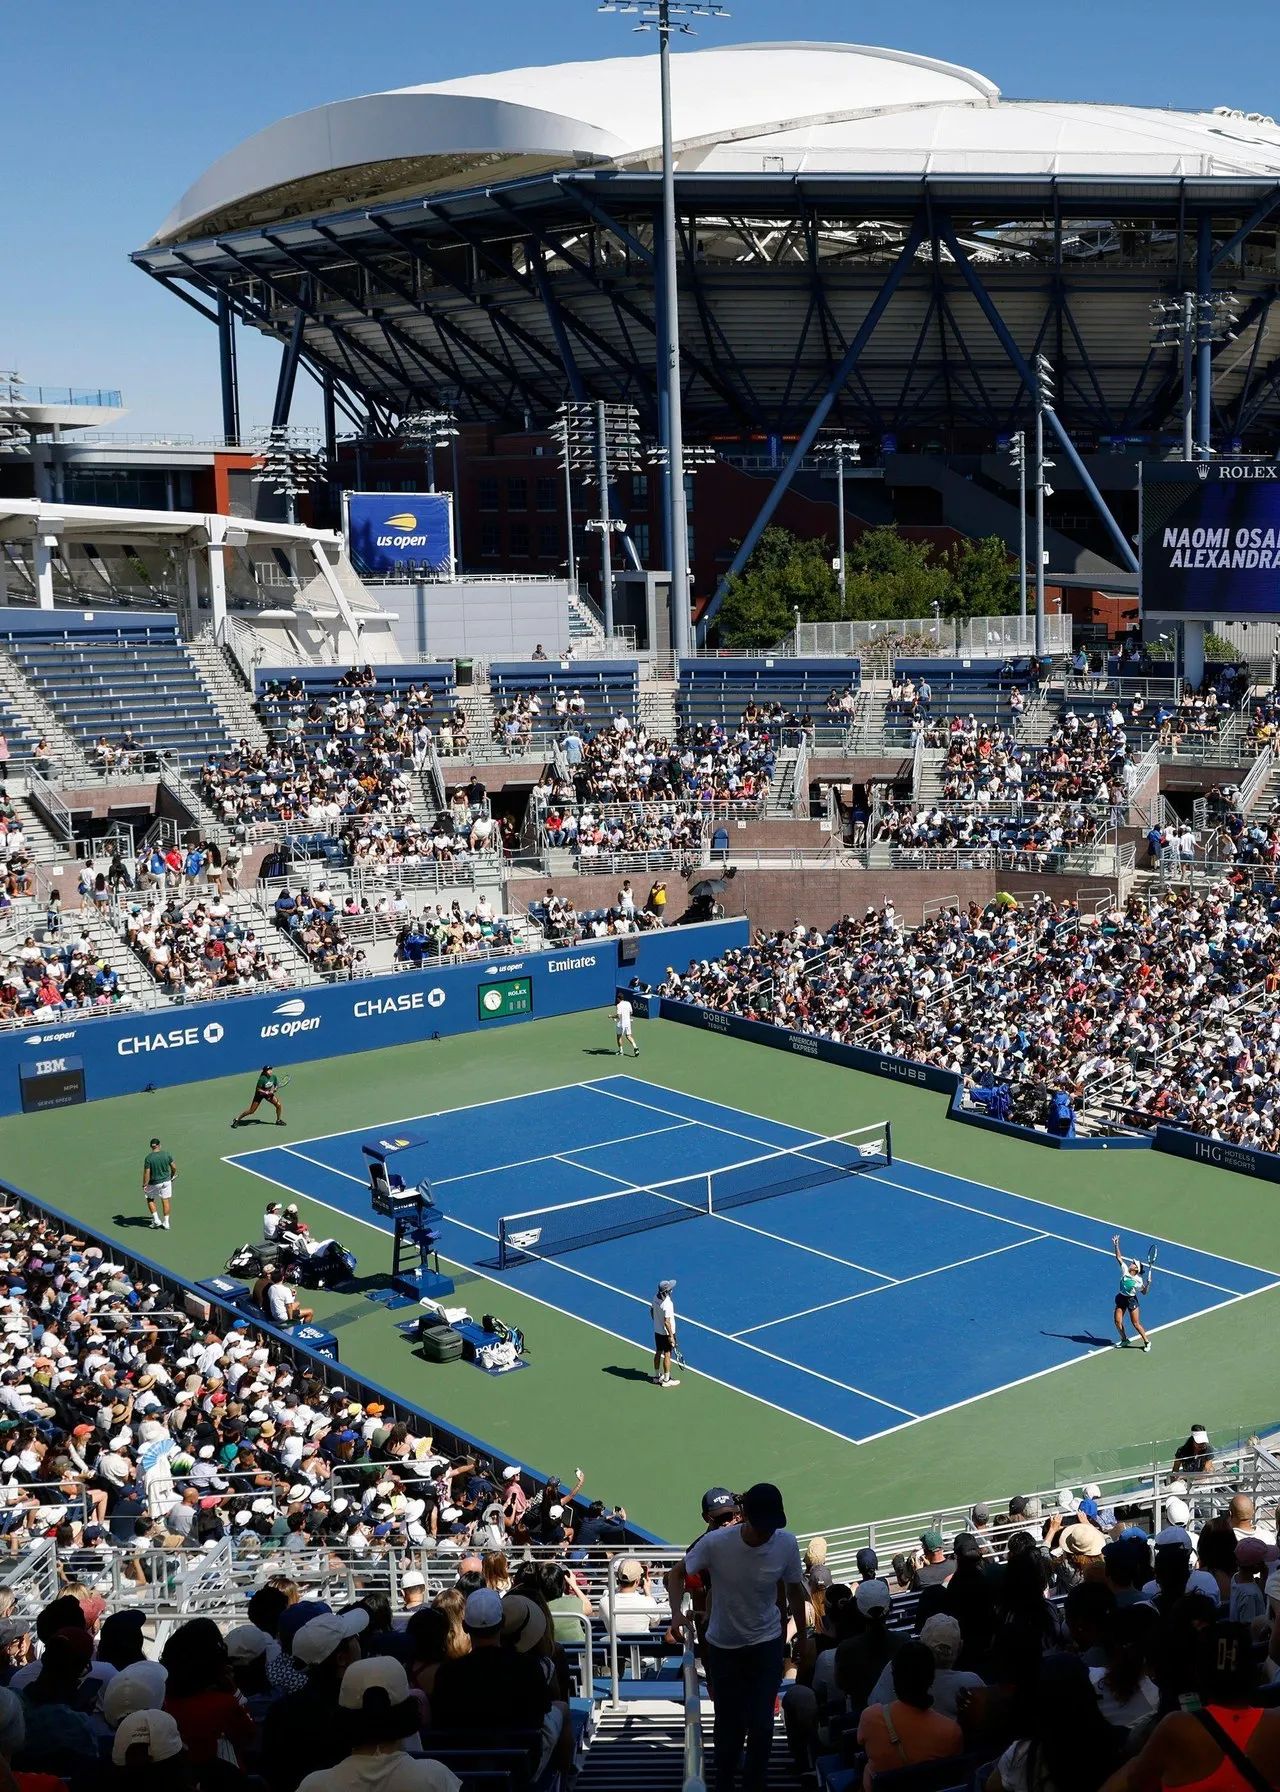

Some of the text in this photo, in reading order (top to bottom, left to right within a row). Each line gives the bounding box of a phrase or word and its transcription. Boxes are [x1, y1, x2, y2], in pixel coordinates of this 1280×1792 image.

[1218, 466, 1278, 479] ROLEX
[376, 535, 427, 549] us open
[1162, 527, 1230, 548] NAOMI
[499, 963, 523, 973] us open
[548, 956, 596, 973] Emirates
[353, 992, 424, 1018] CHASE
[702, 1011, 731, 1026] DOBEL
[261, 1017, 320, 1038] us open
[707, 1022, 727, 1032] TEQUILA
[43, 1031, 75, 1042] us open
[117, 1026, 200, 1055] CHASE
[789, 1035, 818, 1048] AMERICAN
[792, 1043, 818, 1055] EXPRESS
[35, 1058, 67, 1075] IBM
[880, 1061, 927, 1081] CHUBB
[63, 1084, 79, 1092] MPH
[1195, 1141, 1222, 1161] IHG
[1224, 1149, 1251, 1162] HOTELS
[1224, 1157, 1256, 1171] RESORTS
